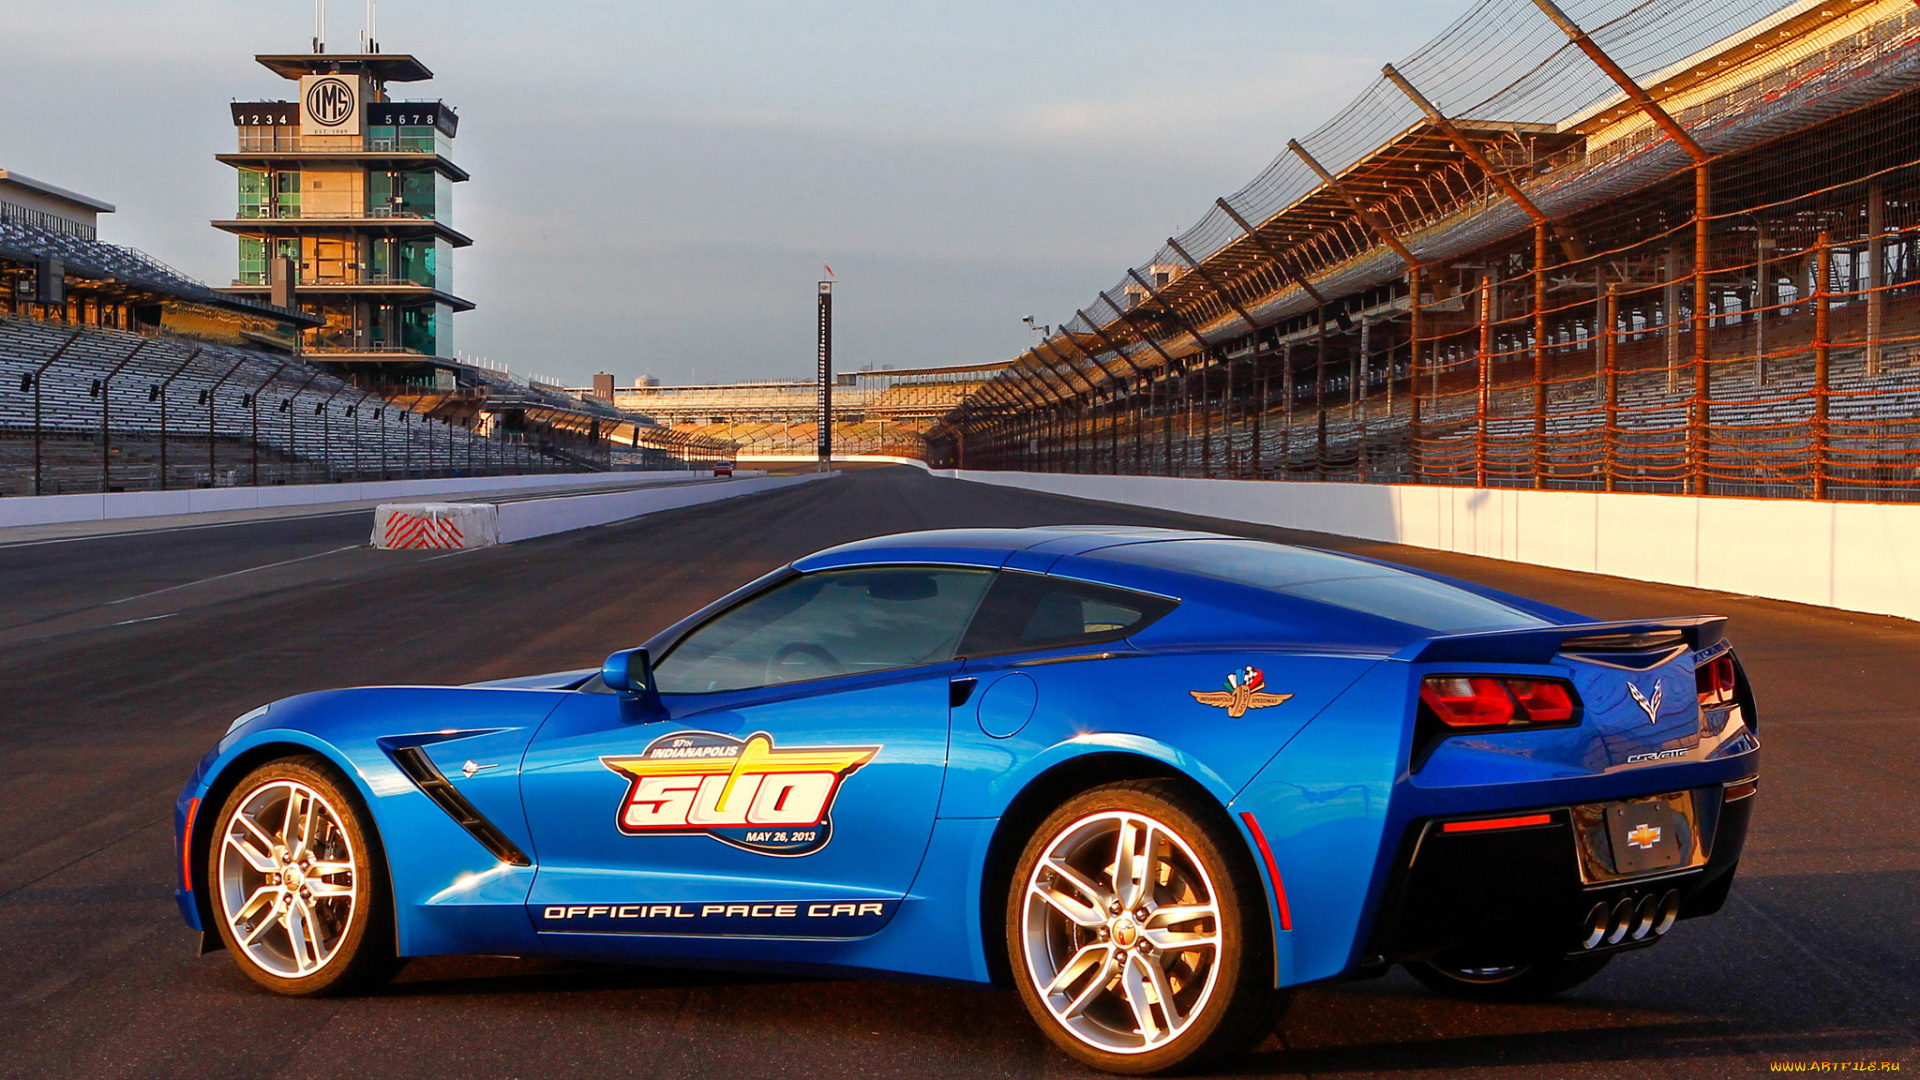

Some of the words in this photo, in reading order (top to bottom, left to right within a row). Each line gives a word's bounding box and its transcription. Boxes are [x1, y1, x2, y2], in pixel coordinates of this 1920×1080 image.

[316, 84, 348, 120] IMS
[238, 114, 245, 125] 1
[251, 114, 260, 125] 2
[265, 114, 273, 125] 3
[279, 114, 287, 125] 4
[384, 114, 393, 125] 5
[398, 114, 406, 125] 6
[412, 114, 420, 125] 7
[426, 114, 434, 125] 8
[672, 739, 693, 748] 97TH
[650, 745, 739, 759] INDIANAPOLIS
[1627, 748, 1688, 762] CORVETTE
[745, 831, 773, 842] MAY
[772, 831, 789, 843] 26,
[790, 831, 817, 842] 2013
[543, 904, 695, 919] OFFICIAL
[701, 904, 797, 918] PACE
[807, 902, 883, 917] CAR
